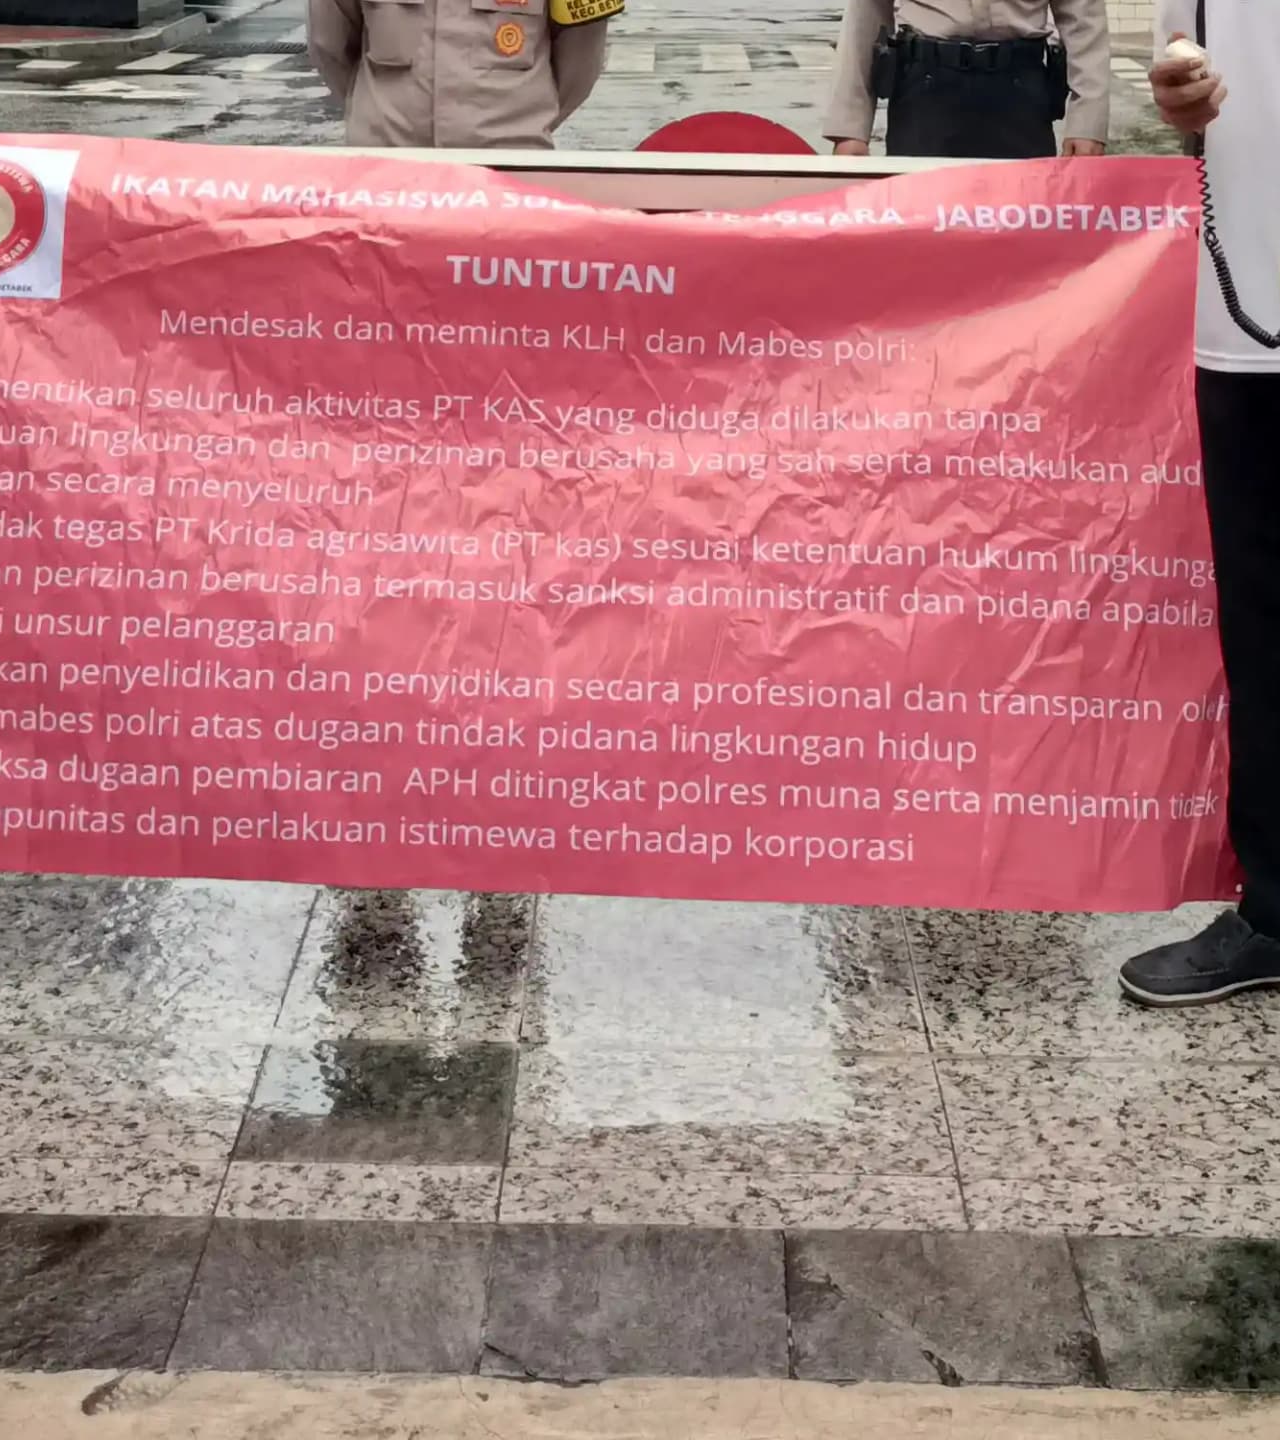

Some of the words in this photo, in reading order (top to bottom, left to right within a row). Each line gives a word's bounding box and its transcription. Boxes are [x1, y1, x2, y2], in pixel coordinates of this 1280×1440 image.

[111, 175, 250, 202] IKATAN
[260, 183, 489, 209] MAHASISWA
[703, 208, 904, 227] TEGGARA
[933, 203, 1190, 233] JABODETABEK
[446, 254, 676, 295] TUNTUTAN
[161, 309, 323, 340] Mendesak
[334, 312, 394, 342] dan
[406, 318, 551, 349] meminta
[562, 324, 626, 351] KLH
[645, 327, 706, 355] dan
[720, 329, 824, 360] Mabes
[147, 384, 275, 417] seluruh
[284, 388, 421, 421] aktivitas
[433, 396, 473, 421] PT
[483, 396, 545, 423] KAS
[556, 405, 636, 436] yang
[647, 403, 760, 437] diduga
[771, 402, 933, 433] dilakukan
[946, 406, 1042, 439] tanpa
[71, 422, 257, 461] lingkungan
[268, 431, 332, 461] dan
[353, 436, 506, 472] perizinan
[520, 445, 676, 472] berusaha
[687, 452, 769, 480] yang
[776, 447, 836, 476] sah
[848, 450, 934, 477] serta
[944, 453, 1131, 485] melakukan
[1140, 460, 1201, 487] aud
[47, 469, 156, 498] secara
[168, 474, 375, 510] menyeluruh
[53, 516, 144, 548] tegas
[155, 516, 198, 544] PT
[208, 517, 296, 549] Krida
[307, 524, 480, 560] agrisawita
[491, 531, 545, 561] (PT
[556, 531, 622, 563] kas)
[632, 533, 741, 562] sesuai
[752, 535, 928, 569] ketentuan
[939, 540, 1058, 574] hukum
[33, 562, 189, 597] perizinan
[200, 564, 362, 597] berusaha
[373, 570, 537, 604] termasuk
[547, 578, 655, 606] sanksi
[666, 582, 890, 615] administratif
[900, 586, 966, 616] dan
[977, 590, 1092, 626] pidana
[1102, 596, 1214, 632] apabila
[14, 612, 108, 638] unsur
[120, 608, 336, 649] pelanggaran
[58, 659, 276, 694] penyelidikan
[286, 663, 352, 693] dan
[363, 667, 556, 705] penyidikan
[566, 676, 681, 705] secara
[692, 680, 893, 713] profesional
[903, 684, 969, 714] dan
[979, 690, 1163, 725] transparan
[104, 707, 181, 742] polri
[190, 711, 263, 742] atas
[273, 711, 404, 750] dugaan
[415, 717, 526, 749] tindak
[537, 722, 659, 759] pidana
[669, 725, 866, 765] lingkungan
[877, 731, 978, 771] hidup
[58, 752, 181, 790] dugaan
[192, 756, 382, 796] pembiaran
[403, 767, 478, 798] APH
[489, 769, 646, 808] ditingkat
[657, 777, 768, 810] polres
[779, 784, 882, 812] muna
[893, 788, 982, 815] serta
[993, 789, 1161, 824] menjamin
[1169, 788, 1219, 821] tidak
[136, 807, 200, 838] dan
[211, 809, 387, 846] perlakuan
[399, 817, 556, 851] istimewa
[569, 824, 734, 864] terhadap
[744, 831, 914, 867] korporasi
